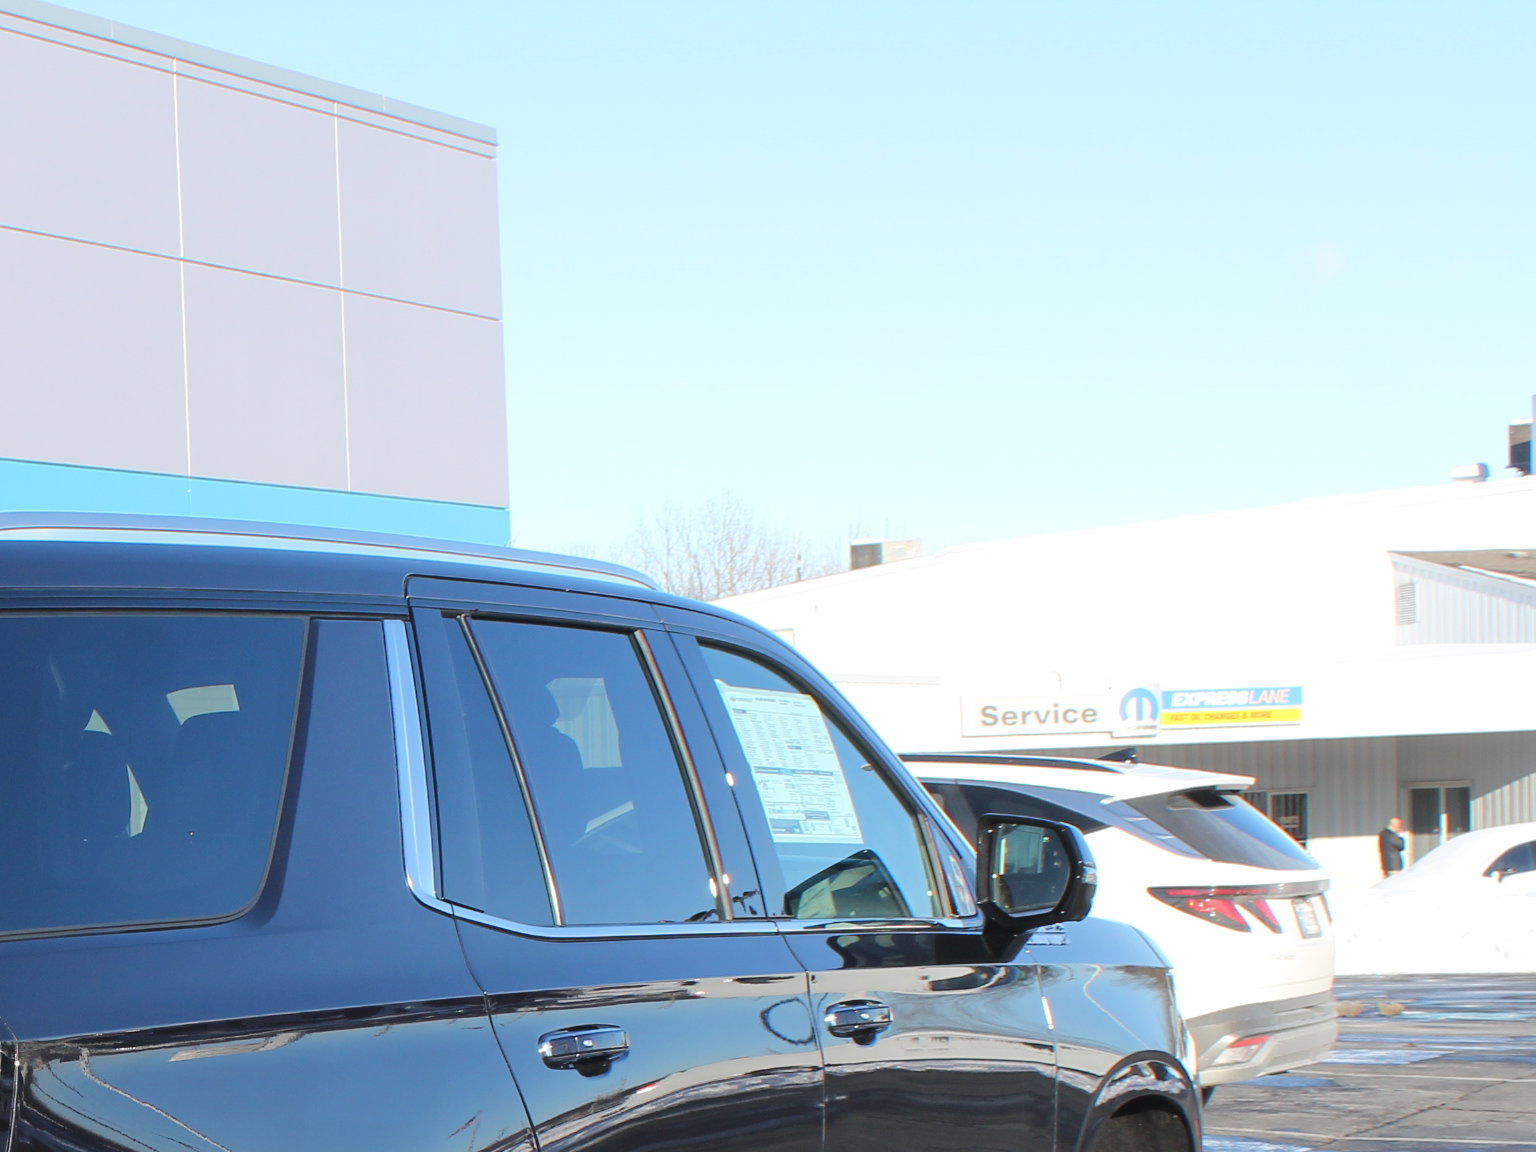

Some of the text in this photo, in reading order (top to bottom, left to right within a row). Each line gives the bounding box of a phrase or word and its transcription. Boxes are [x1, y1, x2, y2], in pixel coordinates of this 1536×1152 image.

[980, 703, 1098, 726] Service
[1170, 713, 1189, 722] FAST
[1204, 711, 1241, 721] CHANGES
[1250, 710, 1273, 720] MORE
